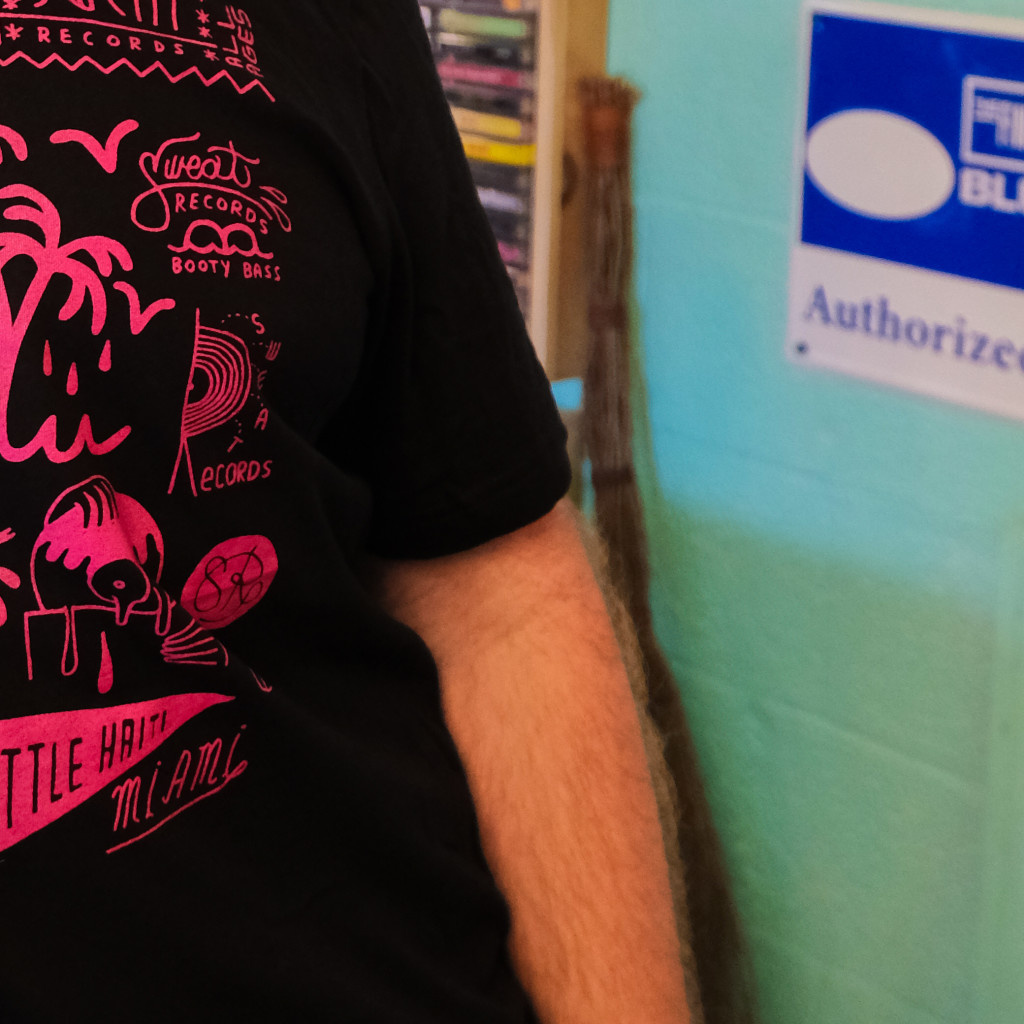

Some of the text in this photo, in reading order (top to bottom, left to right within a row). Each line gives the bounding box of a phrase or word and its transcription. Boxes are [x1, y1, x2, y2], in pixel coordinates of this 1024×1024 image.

[38, 26, 184, 55] RECORDS
[217, 5, 244, 68] ALL
[237, 8, 265, 77] AGES
[175, 192, 268, 234] RECORDS
[958, 166, 1024, 214] BL
[172, 256, 281, 281] BOOTY BASS
[804, 284, 1024, 374] Authorize
[99, 710, 168, 774] HAITI
